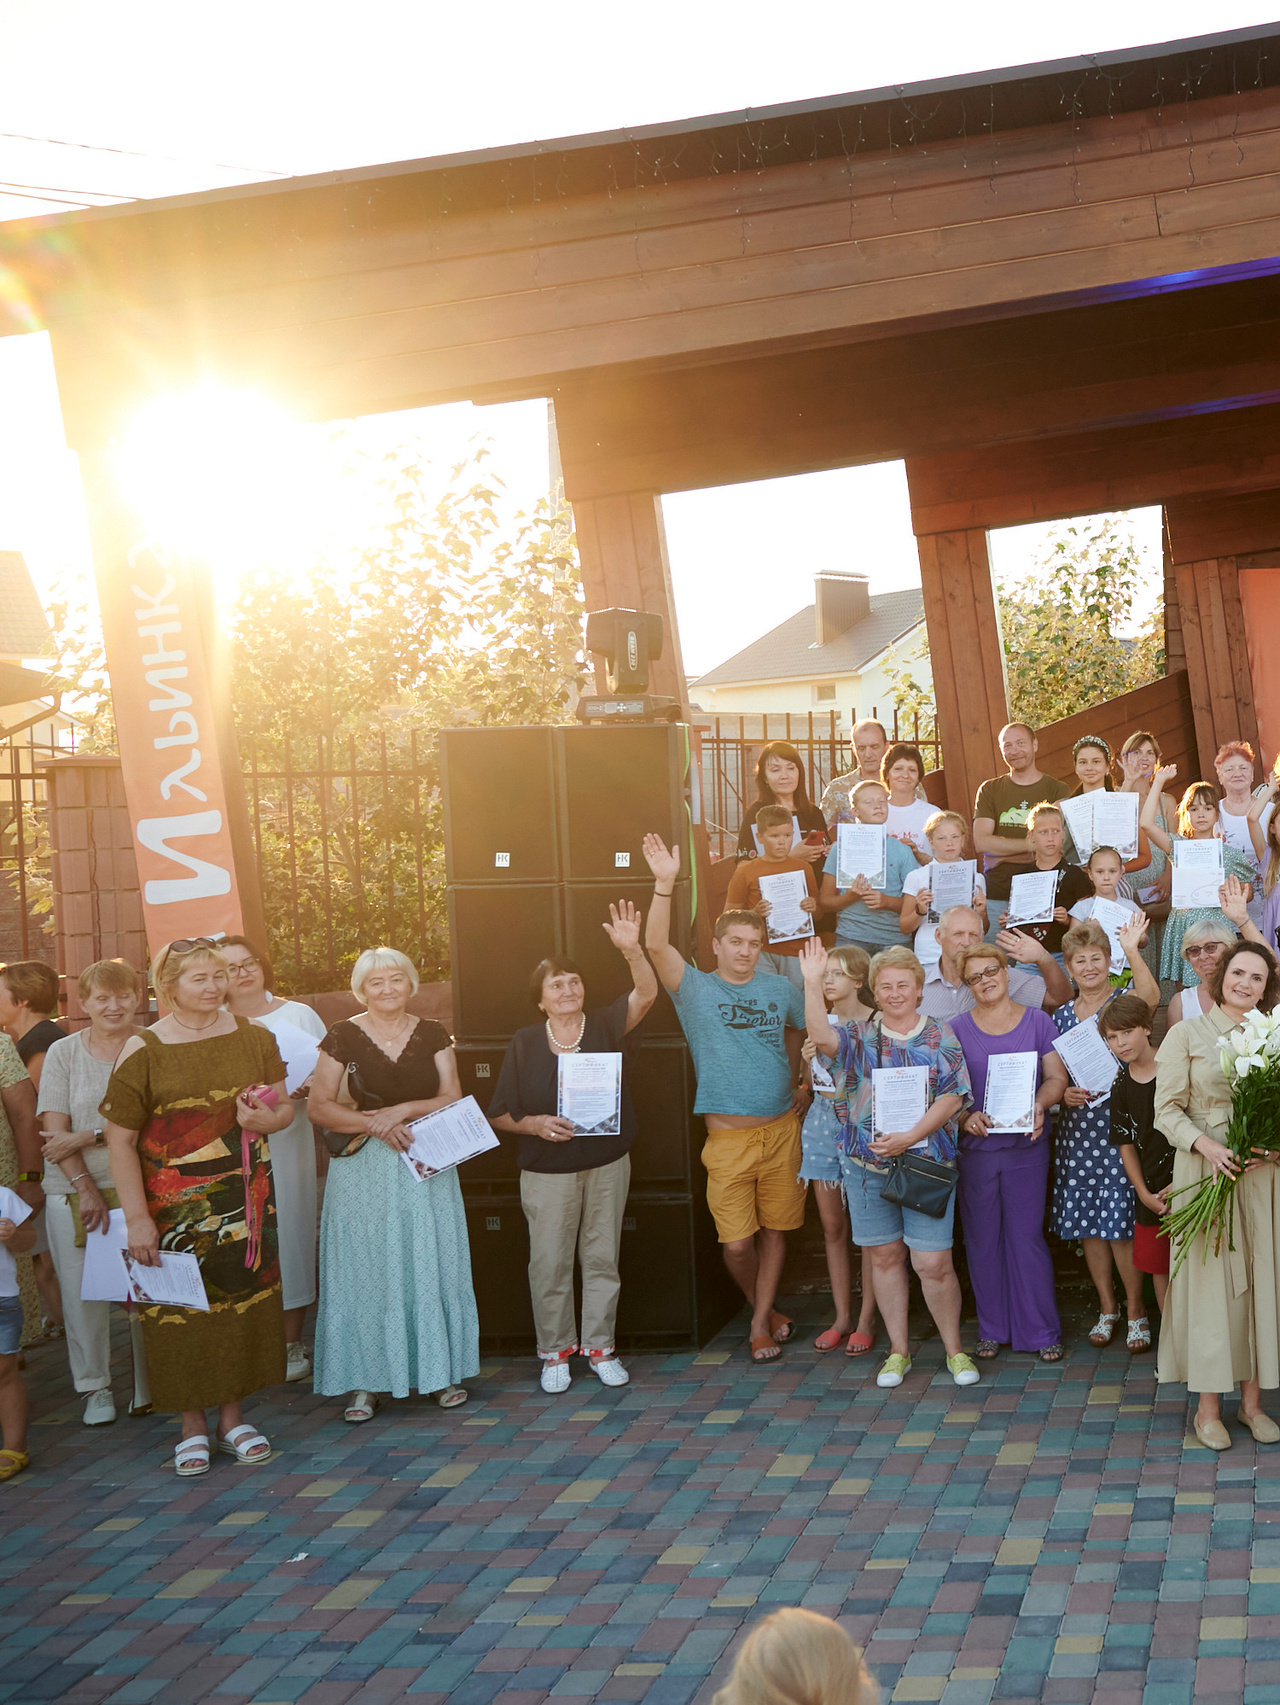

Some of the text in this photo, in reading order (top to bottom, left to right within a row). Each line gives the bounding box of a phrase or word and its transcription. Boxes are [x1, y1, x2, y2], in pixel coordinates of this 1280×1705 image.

[497, 854, 508, 862] HK
[617, 854, 628, 862] HK
[477, 1065, 489, 1073] HK
[883, 1073, 918, 1081] СЕРТИФИКАТ
[487, 1218, 499, 1226] HK
